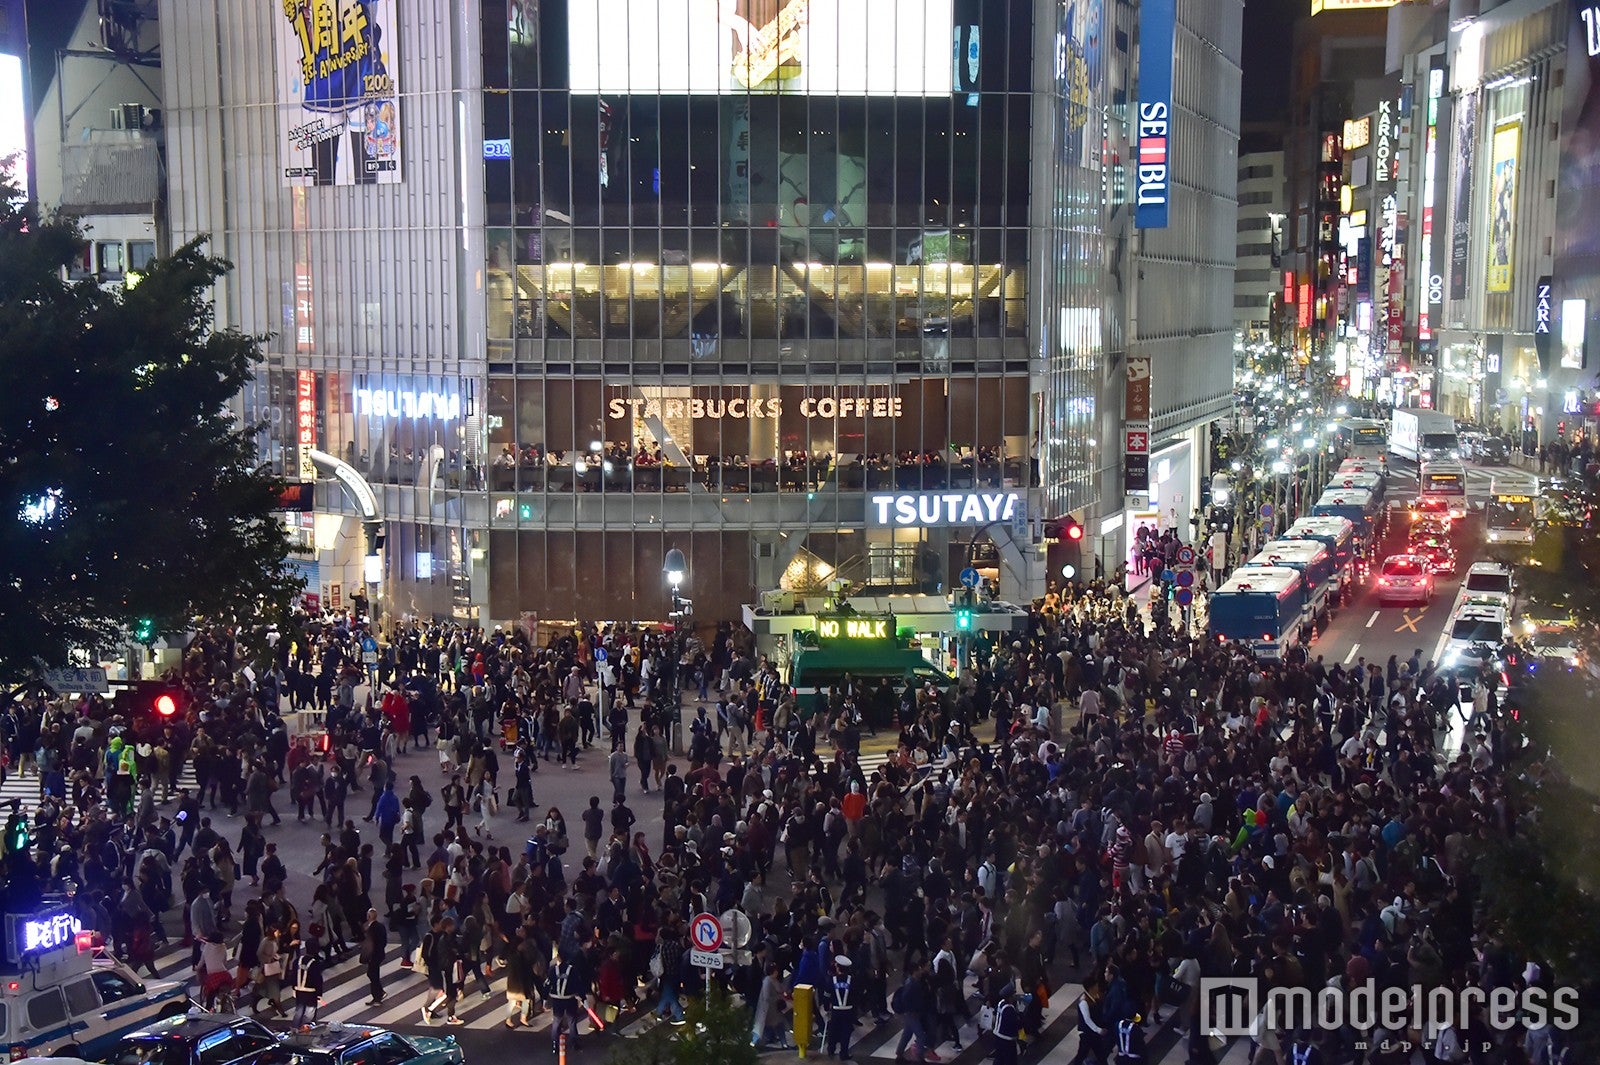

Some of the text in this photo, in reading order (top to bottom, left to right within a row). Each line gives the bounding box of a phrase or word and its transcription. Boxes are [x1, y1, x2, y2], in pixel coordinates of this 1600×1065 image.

[1376, 100, 1391, 182] KARAOKE
[1138, 101, 1168, 207] SEIBU
[1536, 285, 1551, 333] ZARA
[609, 397, 902, 419] STARBUCKS COFFEE
[1129, 433, 1145, 449] 本
[819, 620, 887, 638] NO WALK
[692, 954, 721, 967] ここから
